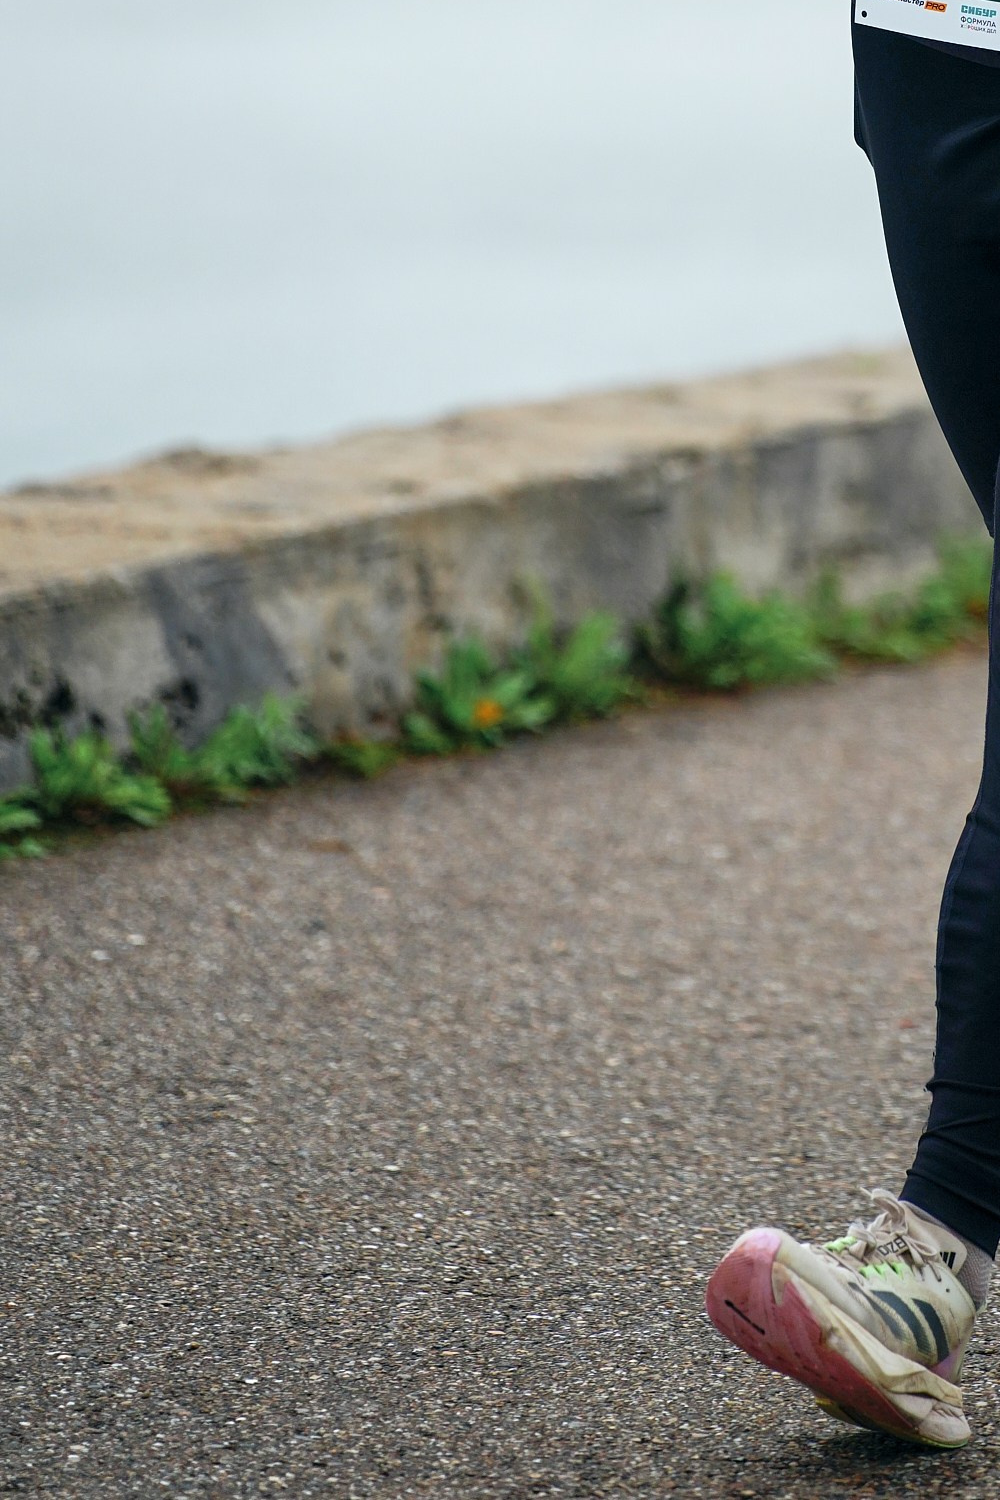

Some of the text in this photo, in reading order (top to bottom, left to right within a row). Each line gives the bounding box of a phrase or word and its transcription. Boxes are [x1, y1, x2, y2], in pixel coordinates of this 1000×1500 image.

[925, 0, 947, 11] PRO
[960, 4, 997, 18] СИБУР
[960, 15, 997, 28] ФОРМУЛА
